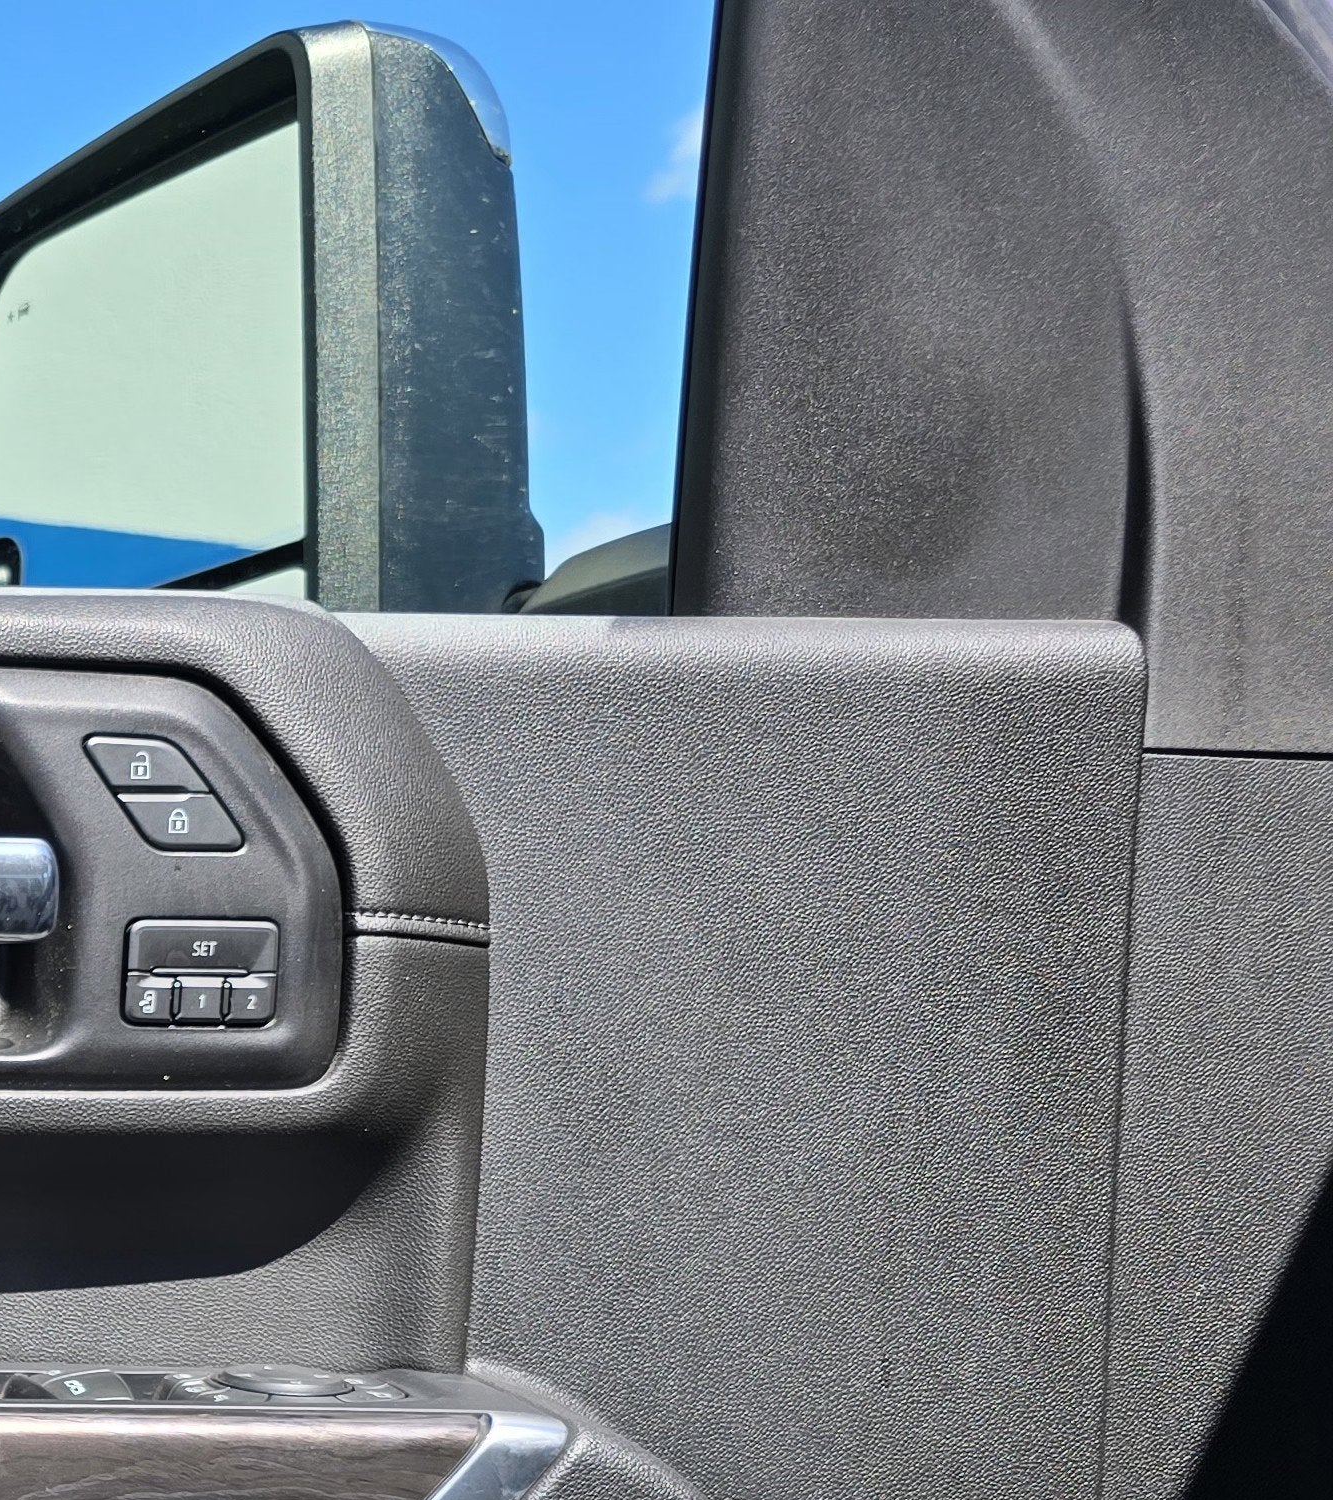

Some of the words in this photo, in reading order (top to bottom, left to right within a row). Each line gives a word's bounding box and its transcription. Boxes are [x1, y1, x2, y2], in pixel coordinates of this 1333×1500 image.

[192, 940, 218, 957] SET
[198, 994, 206, 1009] 1
[247, 995, 258, 1009] 2
